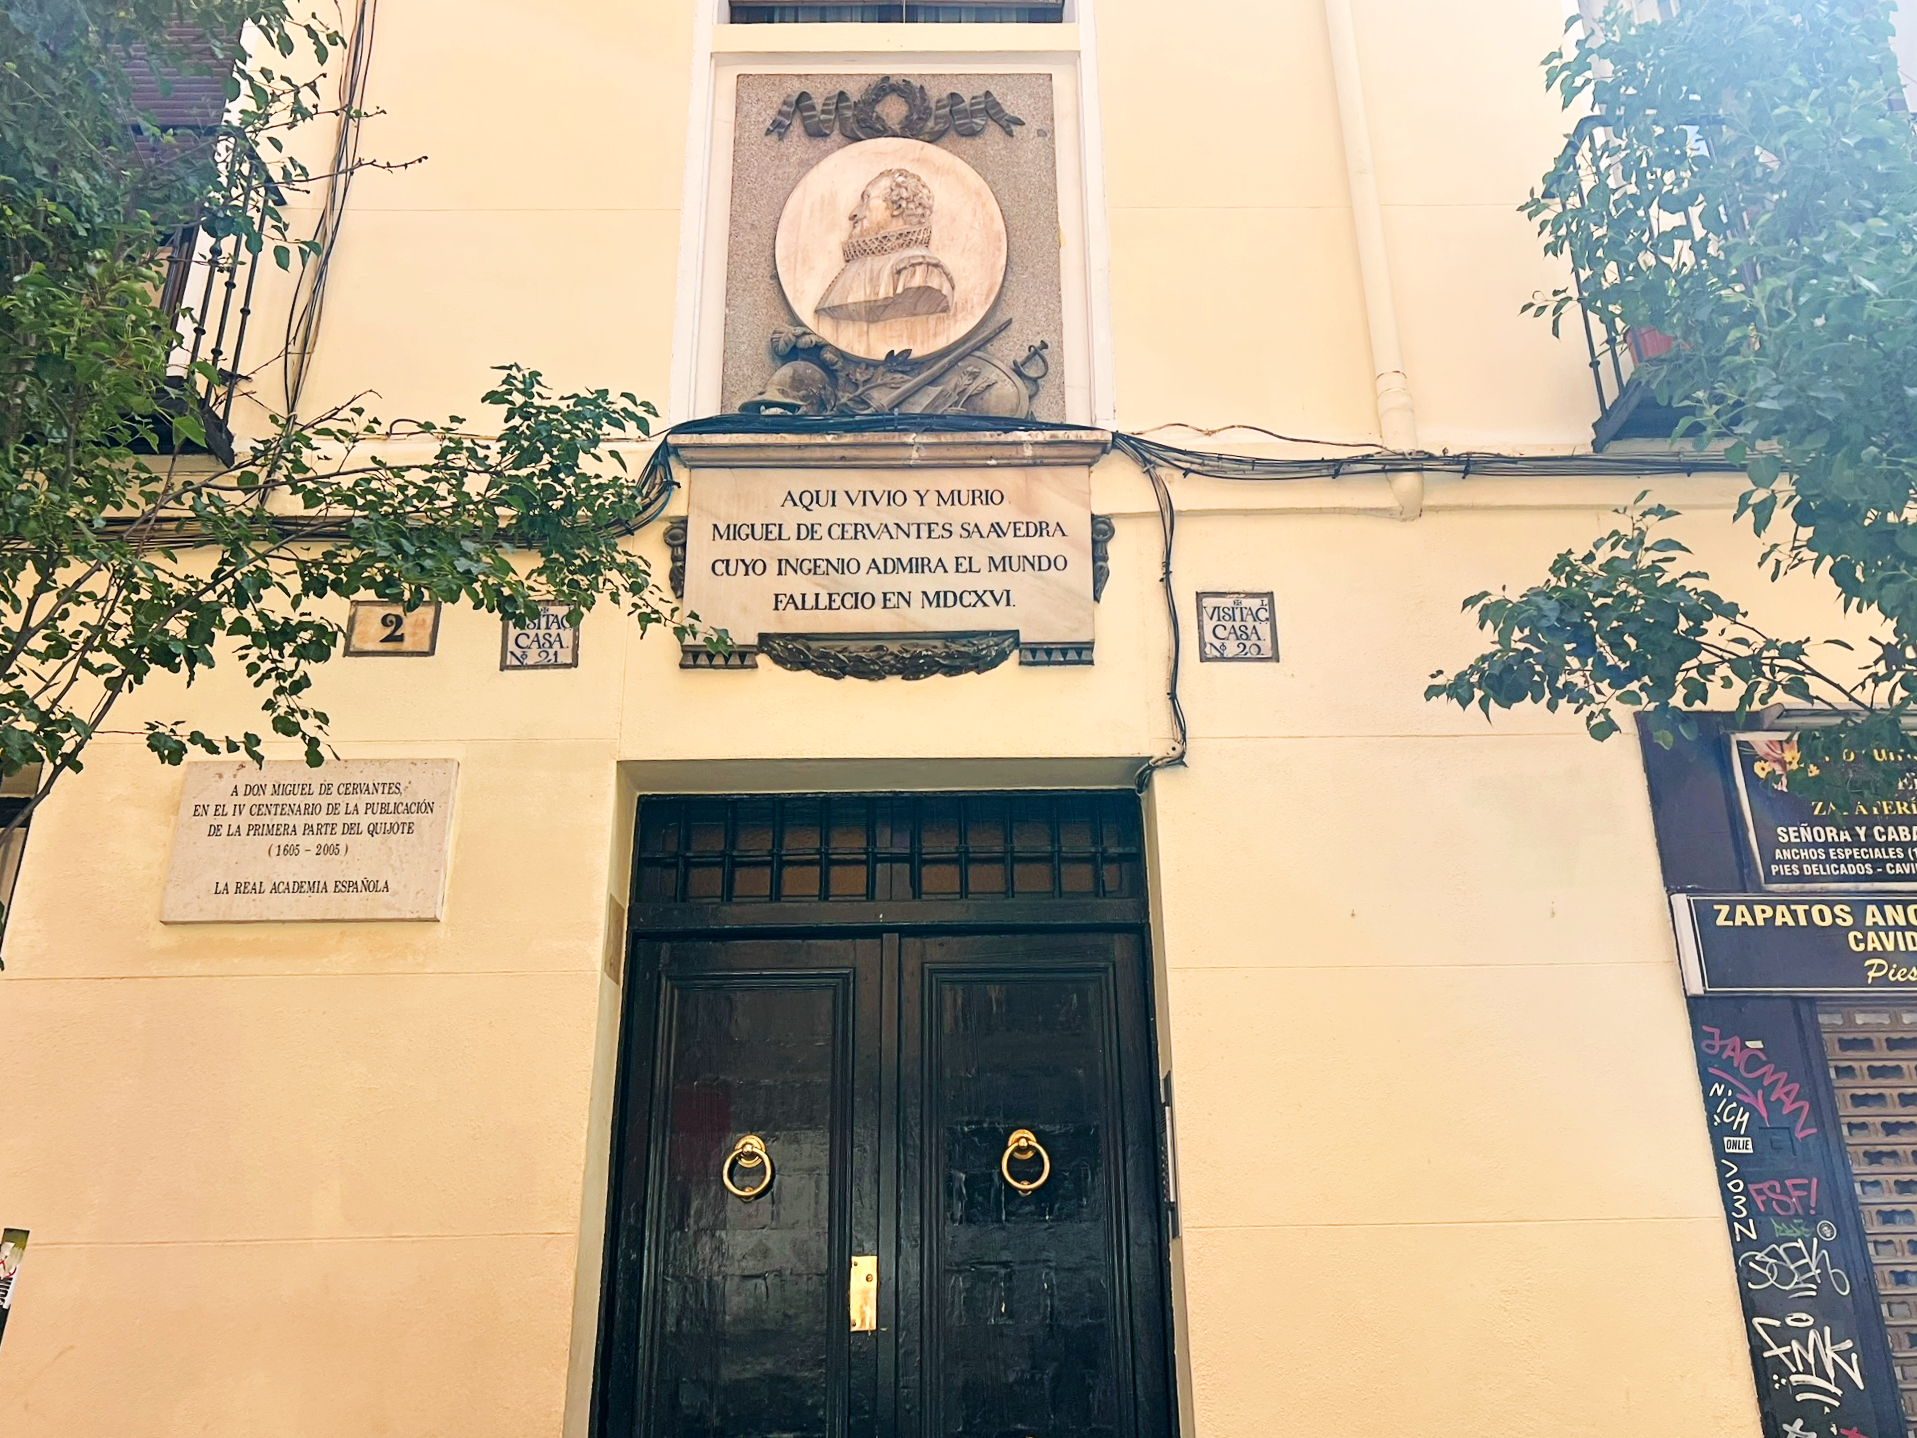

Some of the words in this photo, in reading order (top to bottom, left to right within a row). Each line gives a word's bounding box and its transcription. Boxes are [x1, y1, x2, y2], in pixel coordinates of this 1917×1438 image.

[780, 489, 837, 510] AQUI
[844, 488, 908, 507] VIVIO
[913, 488, 931, 507] Y
[934, 488, 1005, 507] MURIO
[711, 521, 791, 542] MIGUEL
[795, 522, 824, 542] DE
[827, 520, 954, 542] CERVANTES
[958, 520, 1069, 540] SAAVEDRA
[711, 557, 768, 578] CUYO
[776, 556, 862, 577] INGENIO
[866, 555, 950, 576] ADMIRA
[954, 554, 982, 575] EL
[987, 553, 1069, 574] MUNDO
[772, 590, 876, 612] FALLECIO
[881, 589, 912, 610] EN
[920, 588, 1017, 609] MDCXVI.
[379, 612, 405, 644] 2
[230, 784, 239, 797] A
[243, 783, 267, 797] DON
[271, 783, 315, 797] MIGUEL
[318, 782, 334, 796] DE
[336, 782, 403, 796] CERVANTES,
[193, 804, 210, 818] EN
[213, 804, 228, 817] EL
[232, 804, 246, 817] IV
[249, 803, 322, 817] CENTENARIO
[325, 802, 341, 816] DE
[344, 802, 360, 816] LA
[364, 799, 435, 815] PUBLICACIÓN
[207, 824, 224, 838] DE
[226, 824, 242, 837] LA
[246, 823, 298, 837] PRIMERA
[302, 823, 338, 836] PARTE
[341, 822, 363, 836] DEL
[366, 821, 415, 837] QUIJOTE
[1776, 822, 1853, 843] SEÑORA
[1854, 825, 1867, 842] Y
[1774, 847, 1826, 860] ANCHOS
[1828, 847, 1905, 860] ESPECIALES
[1770, 863, 1801, 876] PIES
[1802, 862, 1874, 876] DELICADOS
[1885, 862, 1917, 875] CAVI
[213, 881, 230, 895] LA
[234, 880, 266, 895] REAL
[269, 880, 328, 895] ACADEMIA
[333, 876, 390, 894] ESPAÑOLA
[1713, 903, 1854, 927] ZAPATOS
